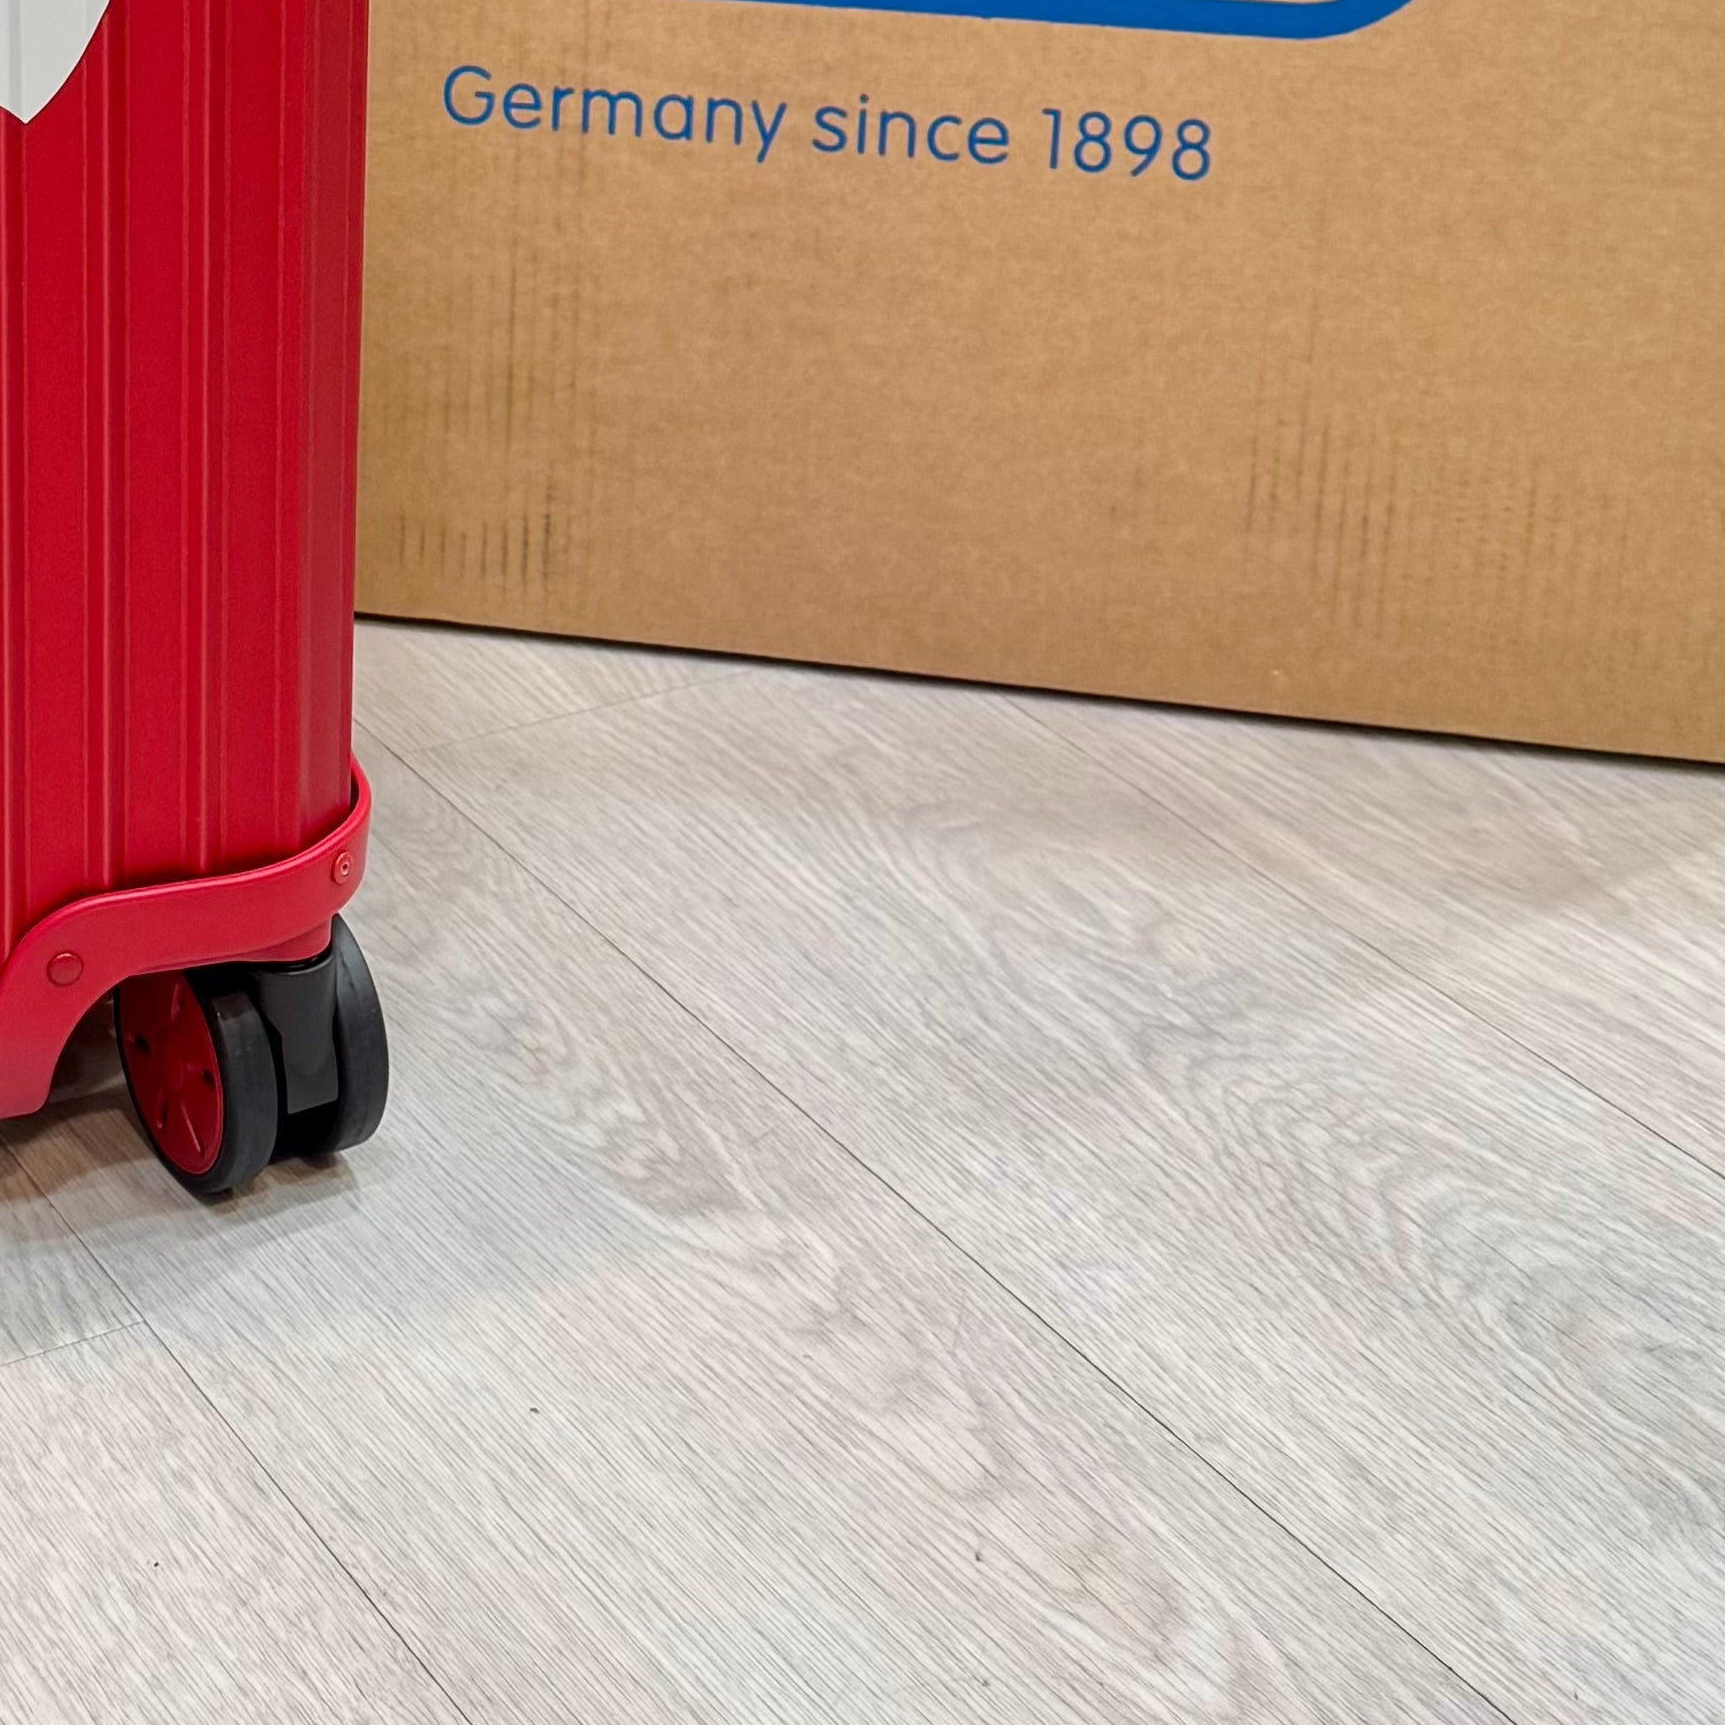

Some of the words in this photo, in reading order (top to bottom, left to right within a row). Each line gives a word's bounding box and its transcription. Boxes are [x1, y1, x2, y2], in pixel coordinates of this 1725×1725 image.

[442, 66, 786, 163] Germany
[812, 93, 1009, 165] since
[1042, 108, 1210, 182] 1898
